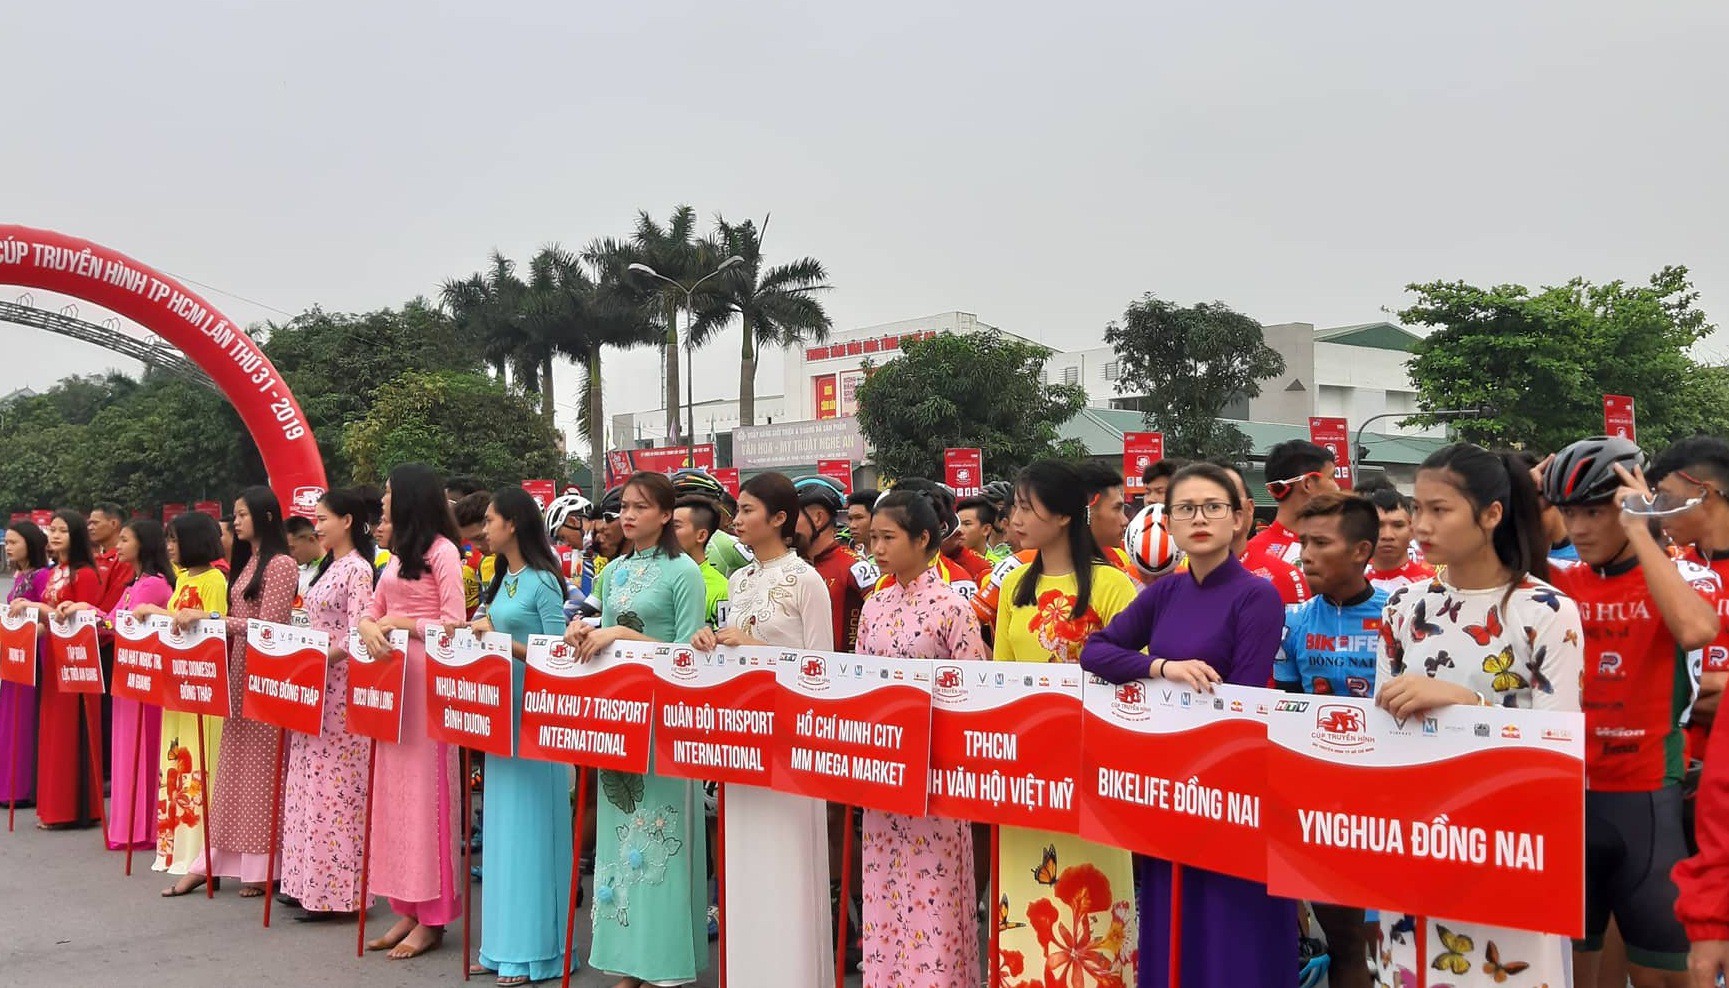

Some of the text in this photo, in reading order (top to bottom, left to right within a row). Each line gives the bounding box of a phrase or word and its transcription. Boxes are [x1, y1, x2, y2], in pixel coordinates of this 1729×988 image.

[32, 244, 102, 279] TRUYỀN
[103, 261, 147, 294] HÌNH
[149, 277, 170, 302] TP
[167, 290, 208, 326] HCM
[251, 366, 274, 394] 31
[270, 397, 305, 441] 2019
[859, 564, 878, 582] 24
[127, 672, 151, 692] AN GIANG
[188, 660, 217, 679] DOMESCO
[196, 682, 213, 703] THÁP
[248, 674, 278, 698] CALYTOS
[300, 686, 320, 707] THÁP
[380, 690, 394, 711] LONG
[436, 676, 499, 706] NHỰA BÌNH MINH
[524, 688, 650, 725] QUÂN KHU 7 TRISPORT
[1275, 700, 1311, 713] HTV
[444, 705, 491, 737] BÌNH DƯƠNG
[663, 701, 775, 735] QUÂN ĐỘI TRISPORT
[796, 708, 904, 750] HỒ CHÍ MINH CITY
[539, 725, 627, 757] INTERNATIONAL
[673, 740, 764, 772] INTERNATIONAL
[963, 730, 1018, 761] TPHCM
[791, 747, 906, 787] MM MEGA MARKET
[946, 765, 977, 800] VĂN
[979, 771, 1006, 807] HỘI
[1009, 772, 1045, 813] VIỆT
[1050, 776, 1075, 811] MỸ
[1098, 766, 1261, 829] BIKELIFE ĐỒNG NAI
[1297, 808, 1544, 873] YNGHUA ĐỒNG NAI
